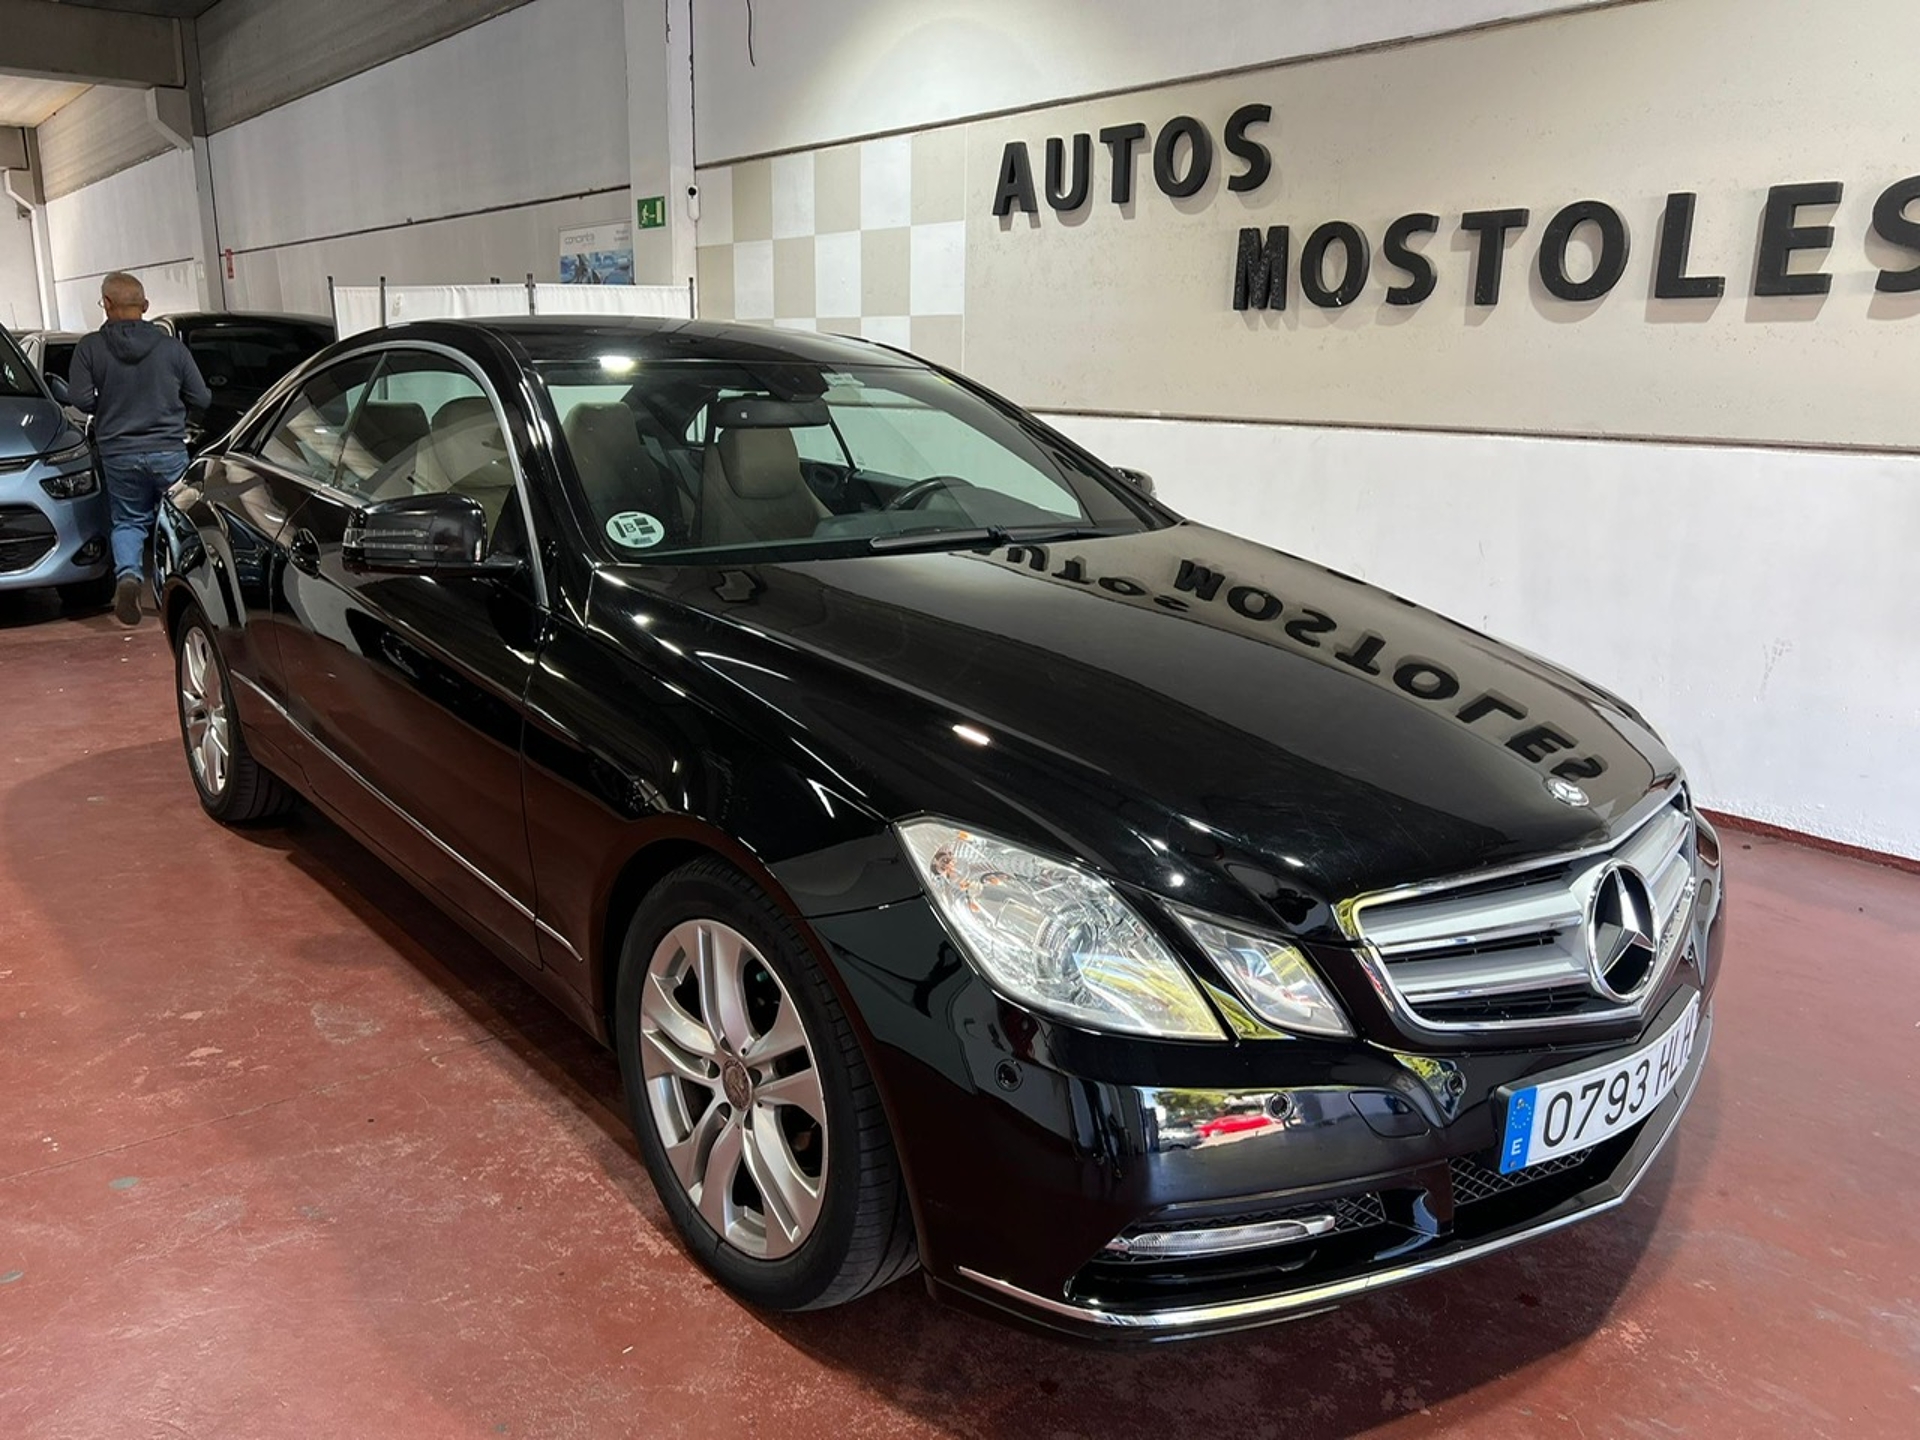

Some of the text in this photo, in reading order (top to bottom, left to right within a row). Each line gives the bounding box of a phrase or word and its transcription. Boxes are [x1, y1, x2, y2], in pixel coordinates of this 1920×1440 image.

[992, 103, 1273, 217] AUTOS
[1232, 174, 1920, 312] MOSTOLES
[1510, 1137, 1523, 1156] E
[1542, 1058, 1651, 1148] 0793
